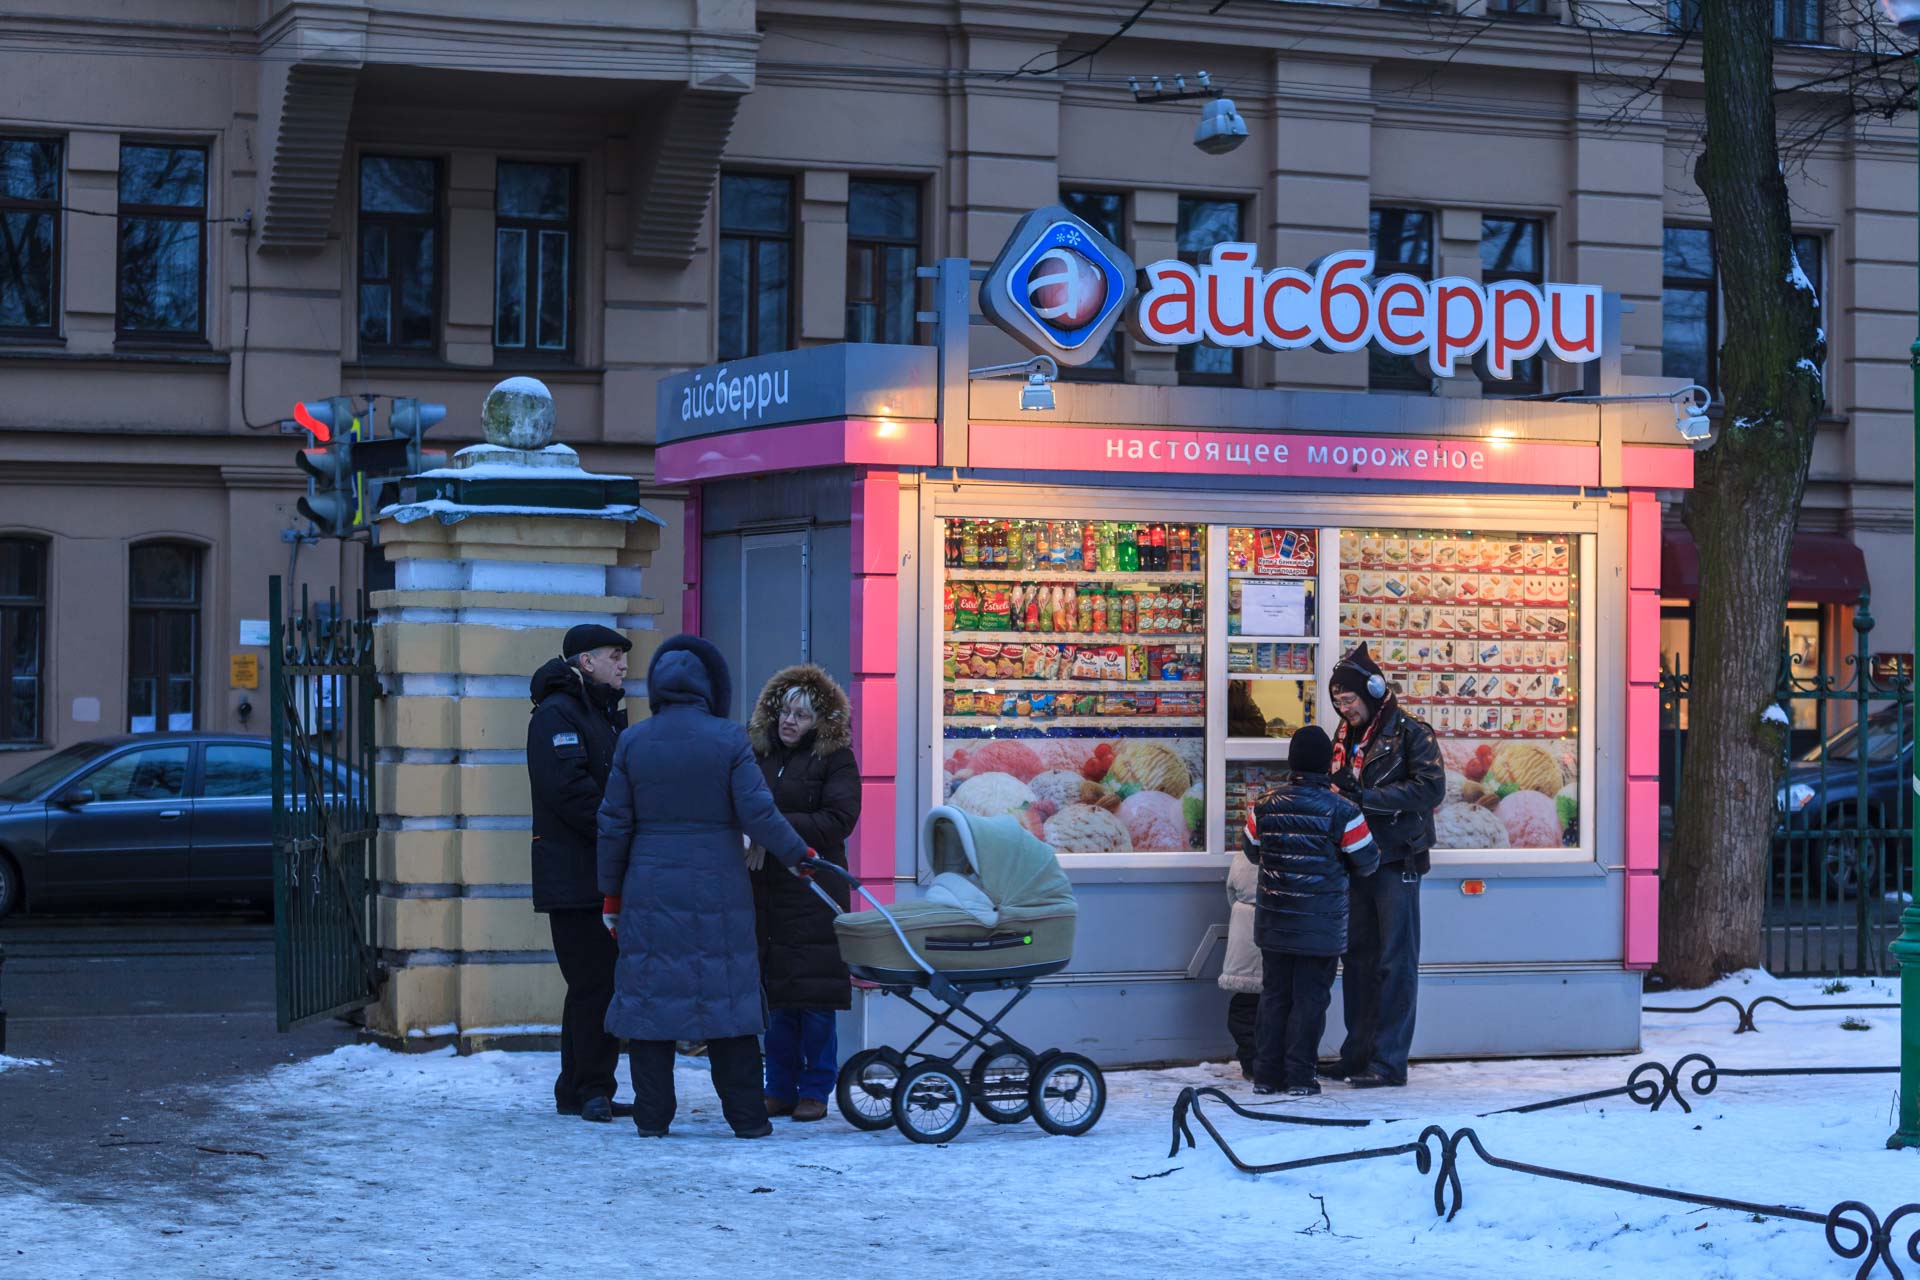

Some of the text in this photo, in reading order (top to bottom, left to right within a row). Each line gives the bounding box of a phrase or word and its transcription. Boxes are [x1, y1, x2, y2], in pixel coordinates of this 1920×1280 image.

[1149, 251, 1595, 370] айсберри
[681, 367, 789, 421] айсберри
[1106, 436, 1484, 469] настоящее мороженое
